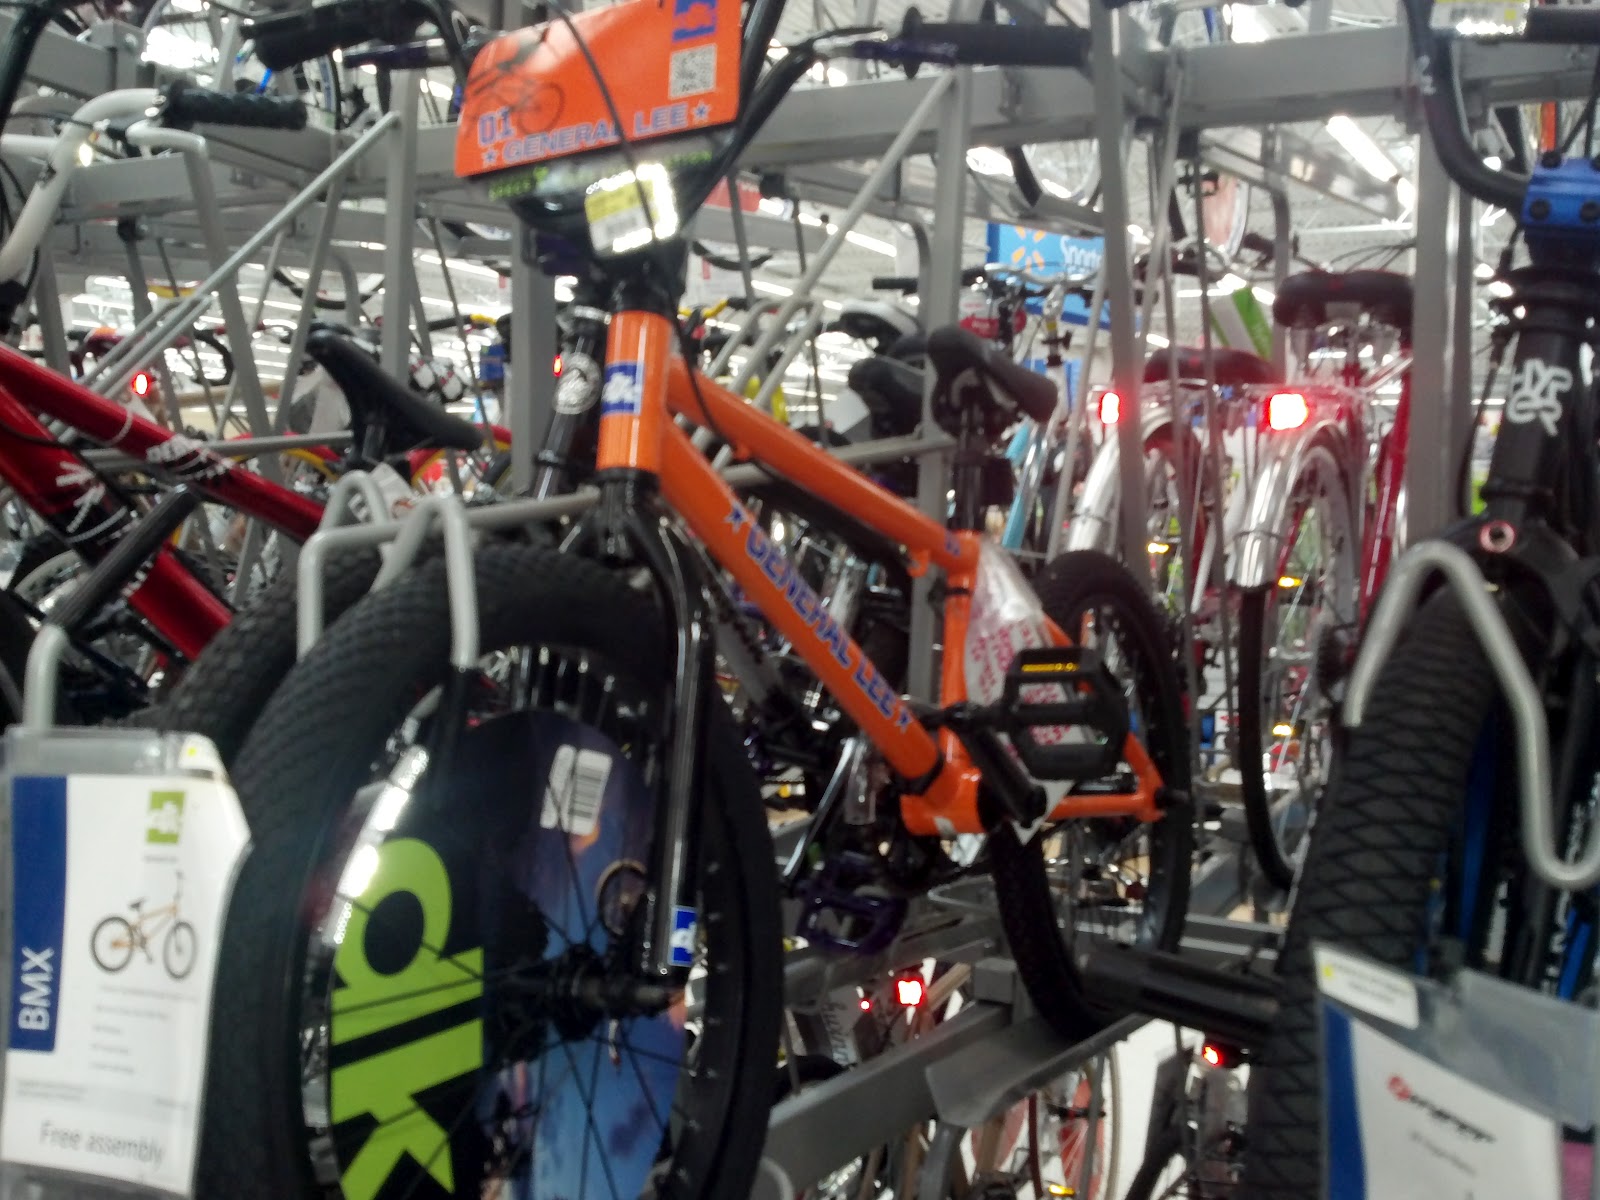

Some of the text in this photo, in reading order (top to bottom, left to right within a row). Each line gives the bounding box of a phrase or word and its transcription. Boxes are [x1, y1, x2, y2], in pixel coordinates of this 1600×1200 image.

[502, 118, 624, 164] GENERAL
[634, 102, 690, 134] LEE
[746, 523, 897, 719] GENERAL LEE
[18, 945, 54, 1032] BMX
[39, 1119, 165, 1172] Free assembly
